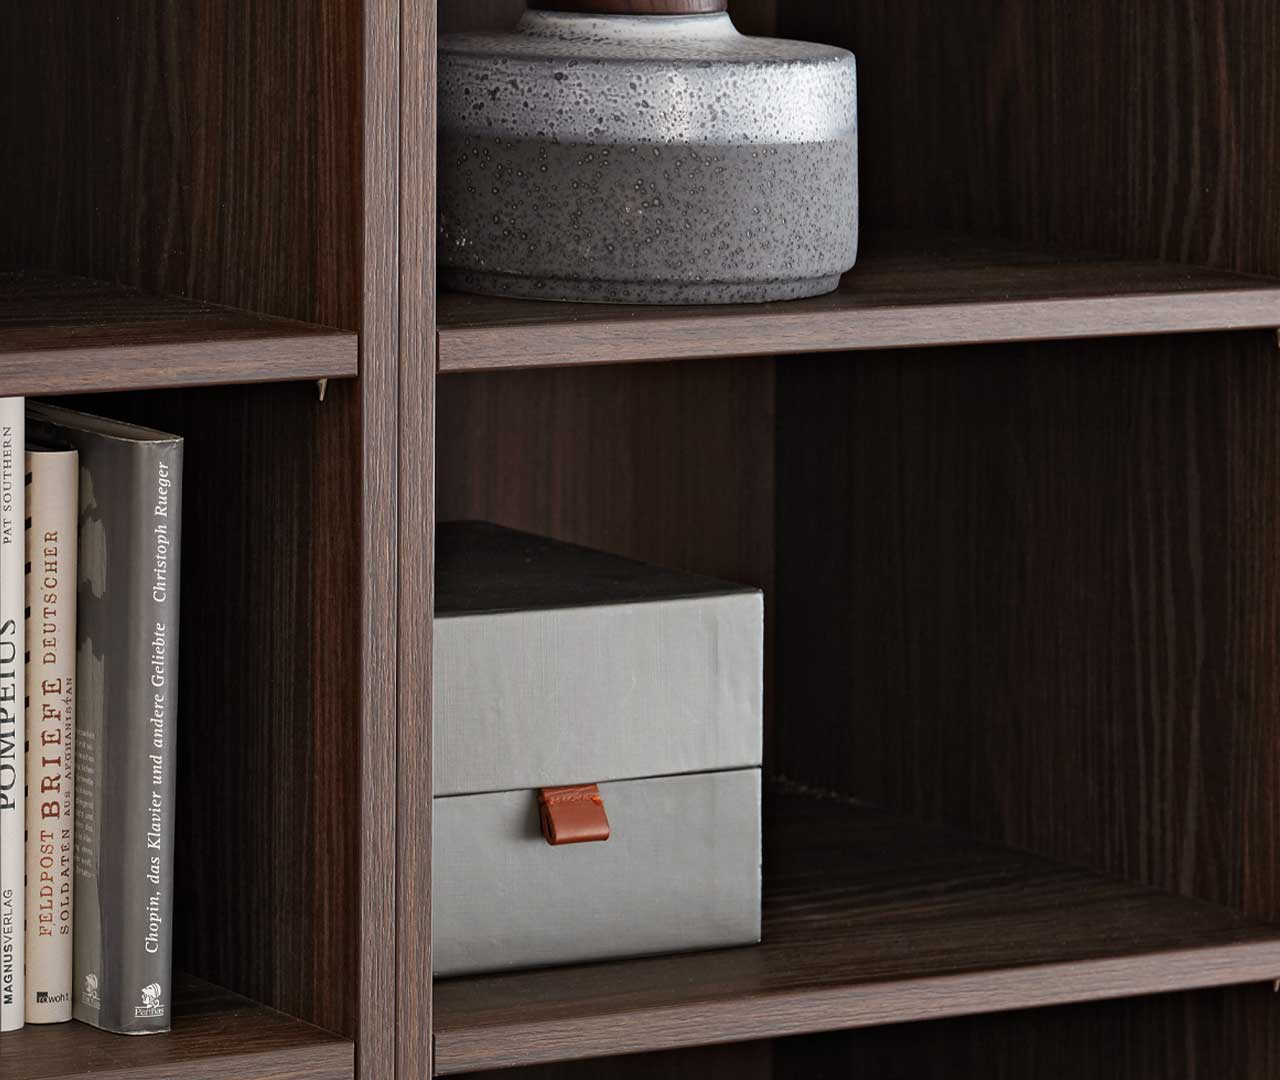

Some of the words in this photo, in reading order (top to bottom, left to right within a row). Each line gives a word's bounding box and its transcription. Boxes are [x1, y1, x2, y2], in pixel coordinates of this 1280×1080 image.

[2, 426, 12, 512] SOUTHERN
[154, 461, 171, 518] Rueger
[2, 518, 12, 545] PAT
[152, 523, 170, 603] Christoph
[42, 530, 59, 665] DEUTSCHER
[151, 622, 167, 688] Geliebte
[40, 677, 62, 820] BRIEFE
[149, 693, 166, 749] andere
[148, 754, 163, 785] und
[147, 791, 162, 851] Klavier
[38, 829, 55, 937] FELDPOST
[59, 828, 71, 935] SOLDATEN
[146, 856, 161, 885] das
[145, 891, 162, 954] Chopin,
